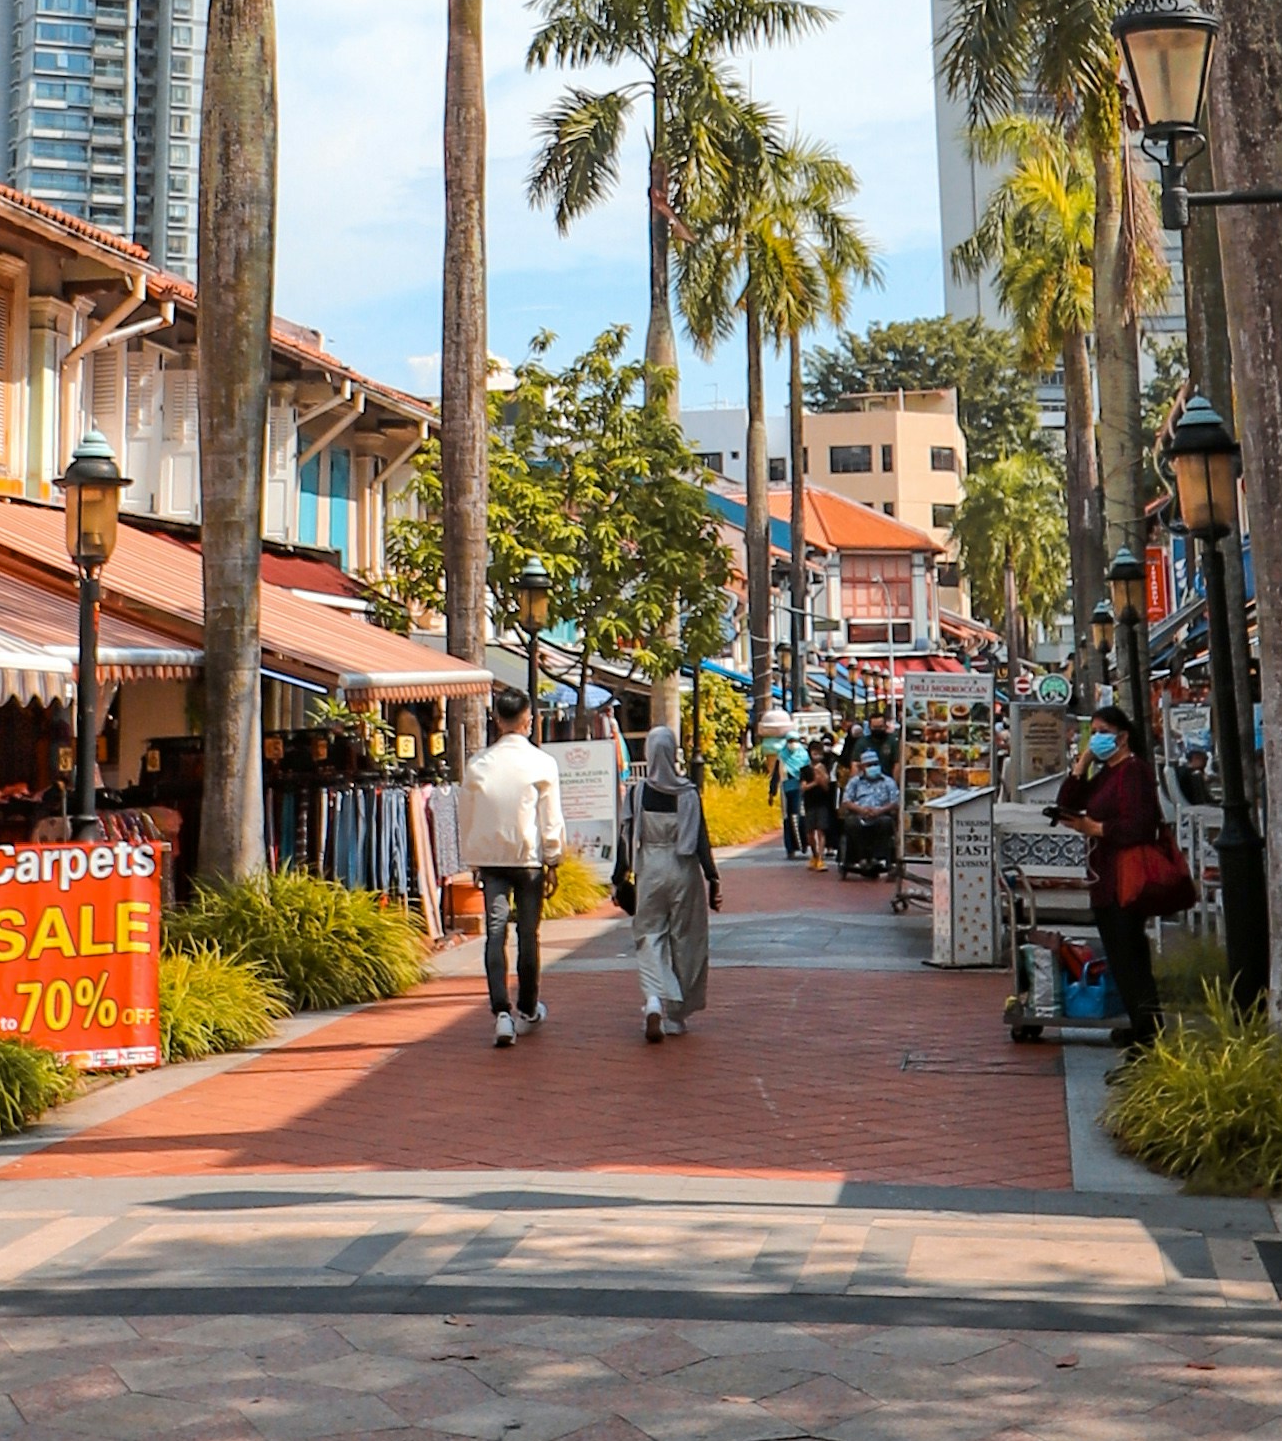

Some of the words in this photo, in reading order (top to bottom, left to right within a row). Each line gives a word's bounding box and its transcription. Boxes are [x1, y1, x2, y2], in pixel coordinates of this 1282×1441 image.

[559, 777, 603, 785] ROMATICS
[955, 834, 989, 842] MIDDLE
[955, 845, 990, 856] EAST
[0, 1015, 18, 1031] to
[15, 971, 118, 1034] 70%
[121, 1008, 156, 1026] OFF
